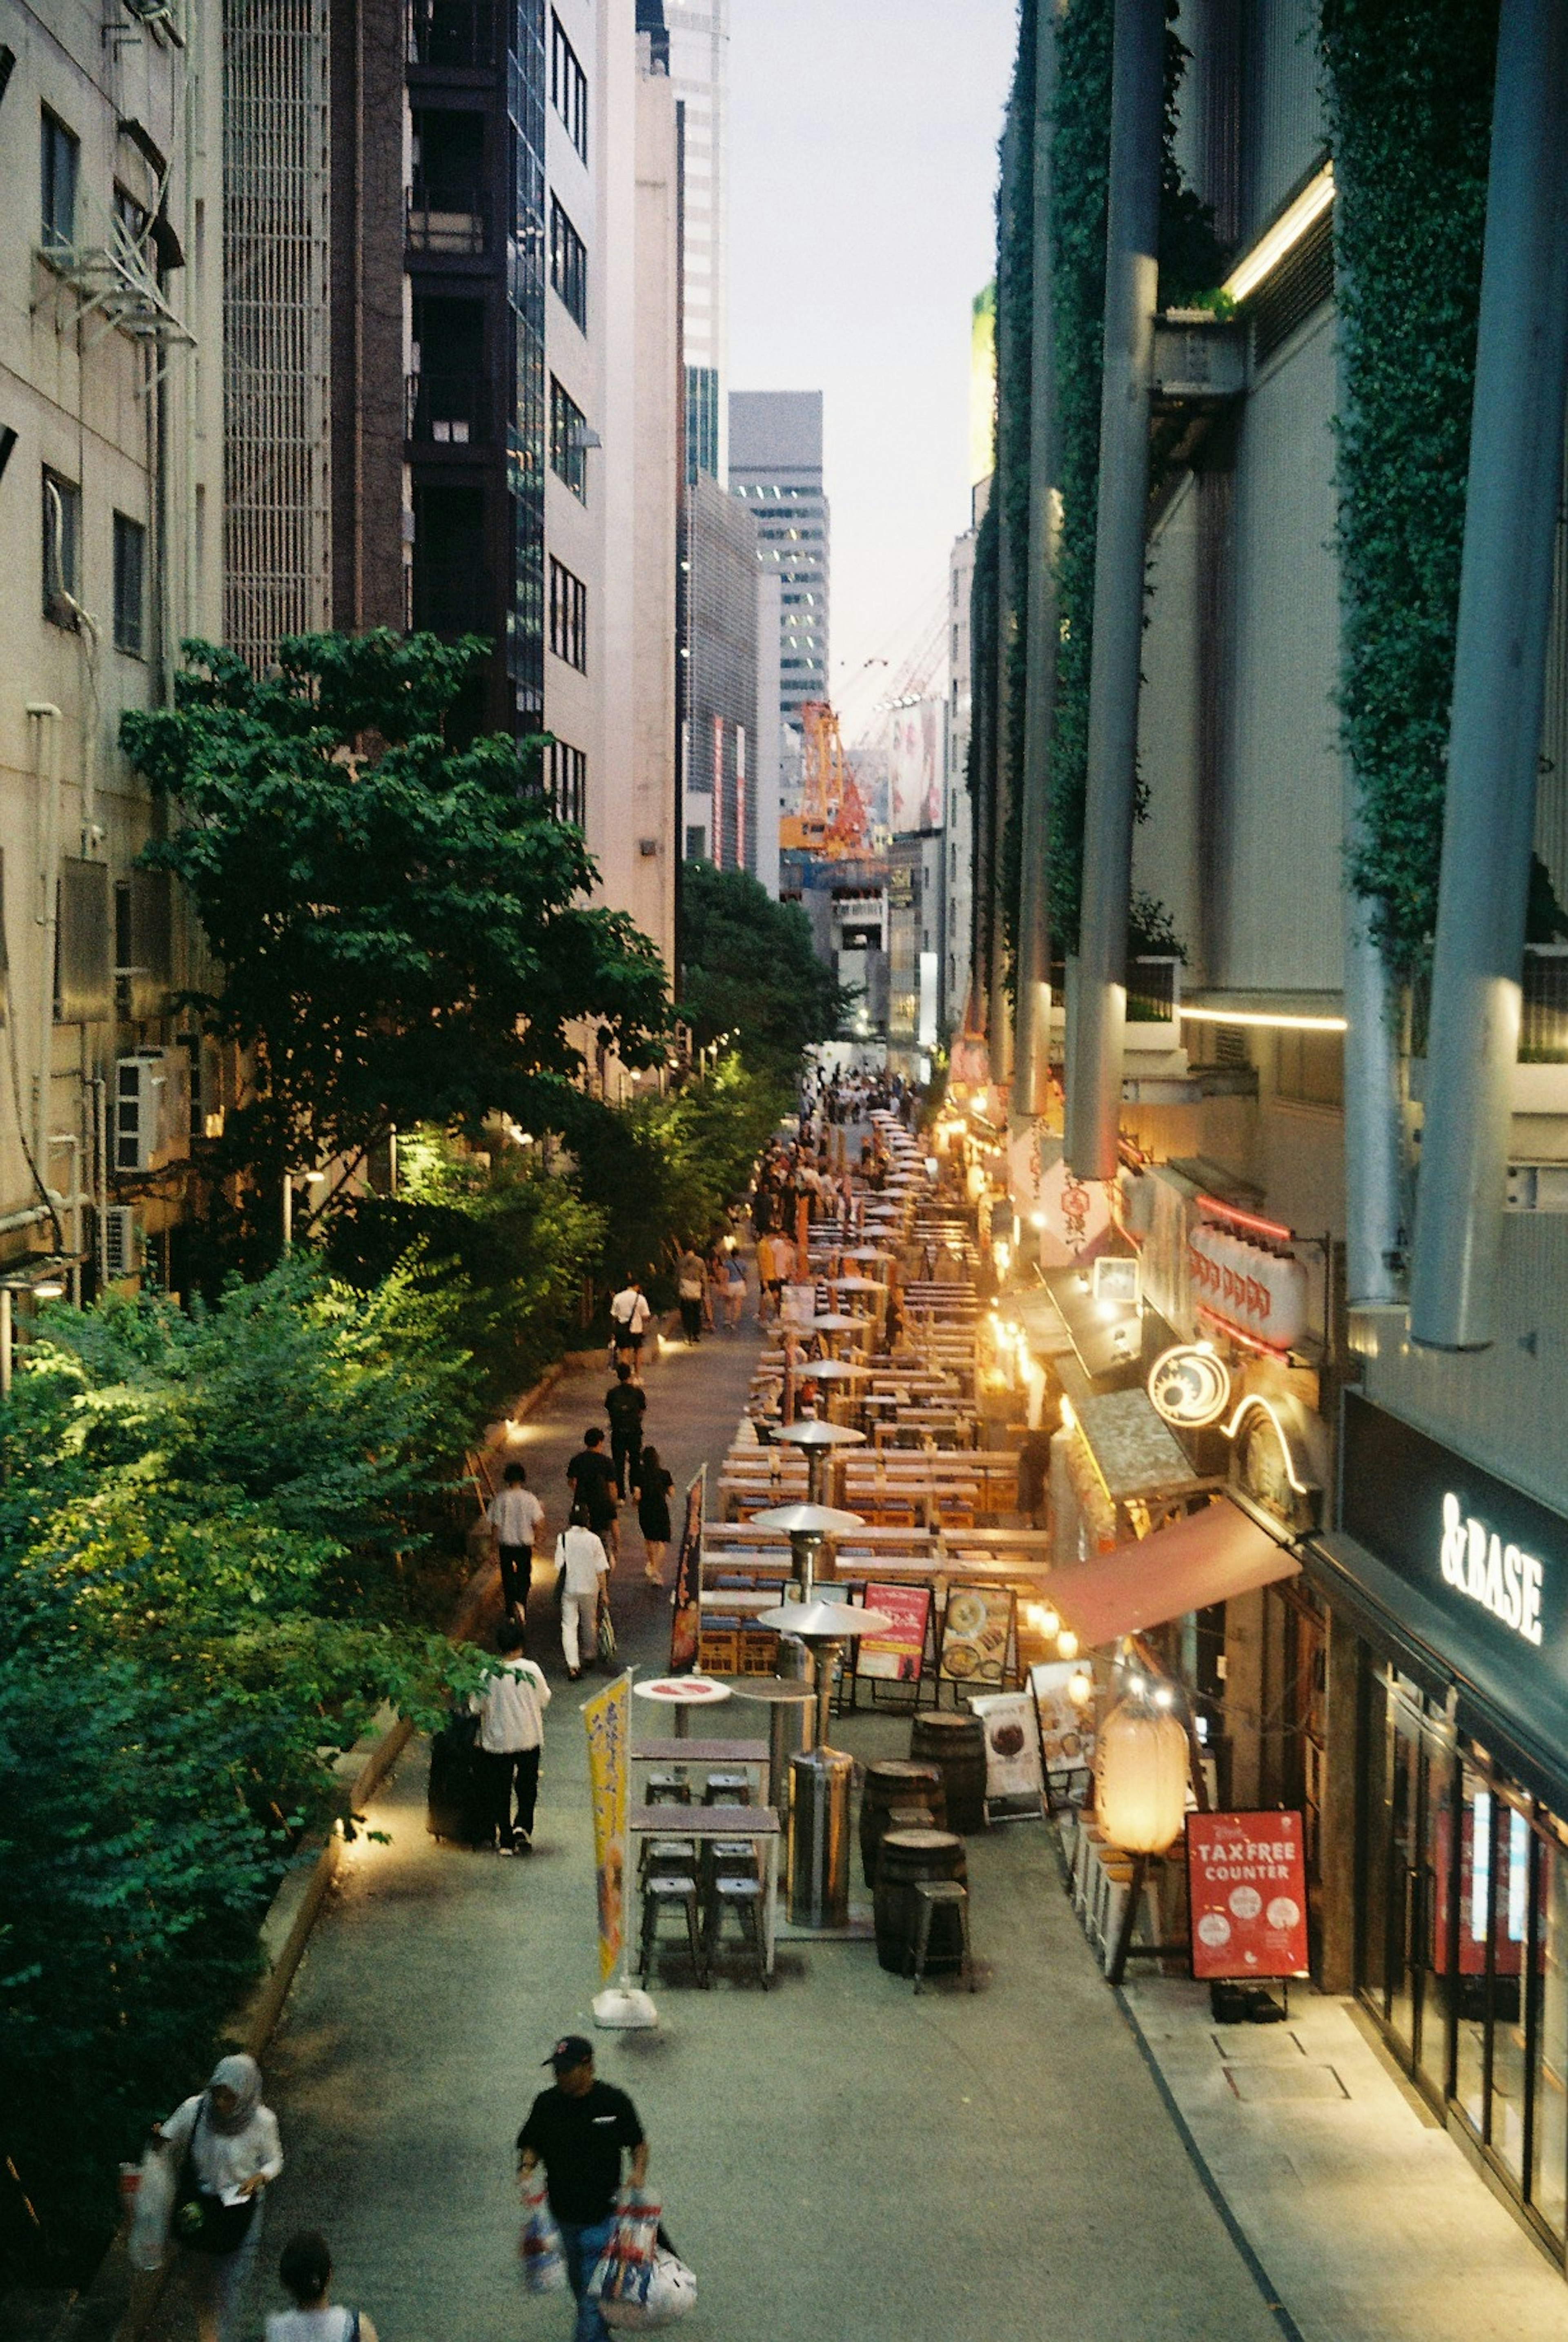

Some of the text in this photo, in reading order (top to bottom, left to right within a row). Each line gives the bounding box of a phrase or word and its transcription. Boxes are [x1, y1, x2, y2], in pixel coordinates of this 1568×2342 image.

[1441, 1493, 1543, 1646] &BASE
[1198, 1842, 1295, 1864] TAX FREE
[1205, 1865, 1289, 1881] COUNTER
